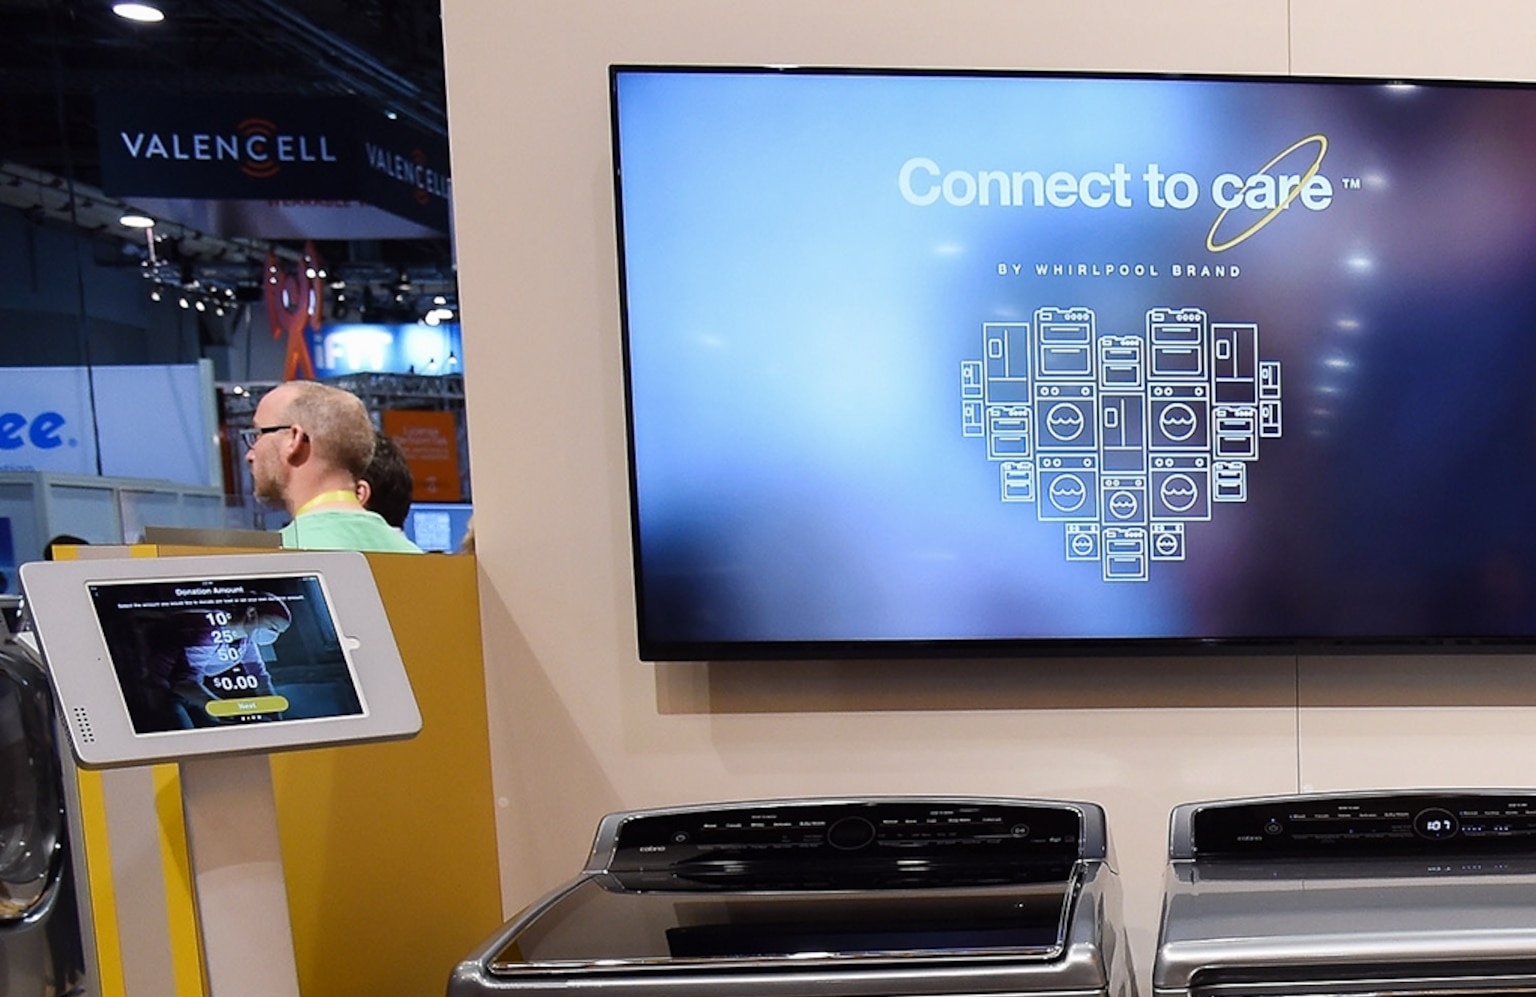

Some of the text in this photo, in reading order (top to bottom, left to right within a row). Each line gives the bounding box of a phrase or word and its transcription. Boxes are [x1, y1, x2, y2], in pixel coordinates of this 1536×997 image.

[121, 131, 337, 162] VALENCELL
[898, 156, 1132, 208] Connect
[1142, 163, 1199, 210] to
[1211, 171, 1333, 211] care
[997, 263, 1242, 278] BY WHIRLPOOL BRAND
[174, 586, 245, 597] Donation Amount
[213, 675, 258, 690] $0.00
[237, 702, 257, 710] Next
